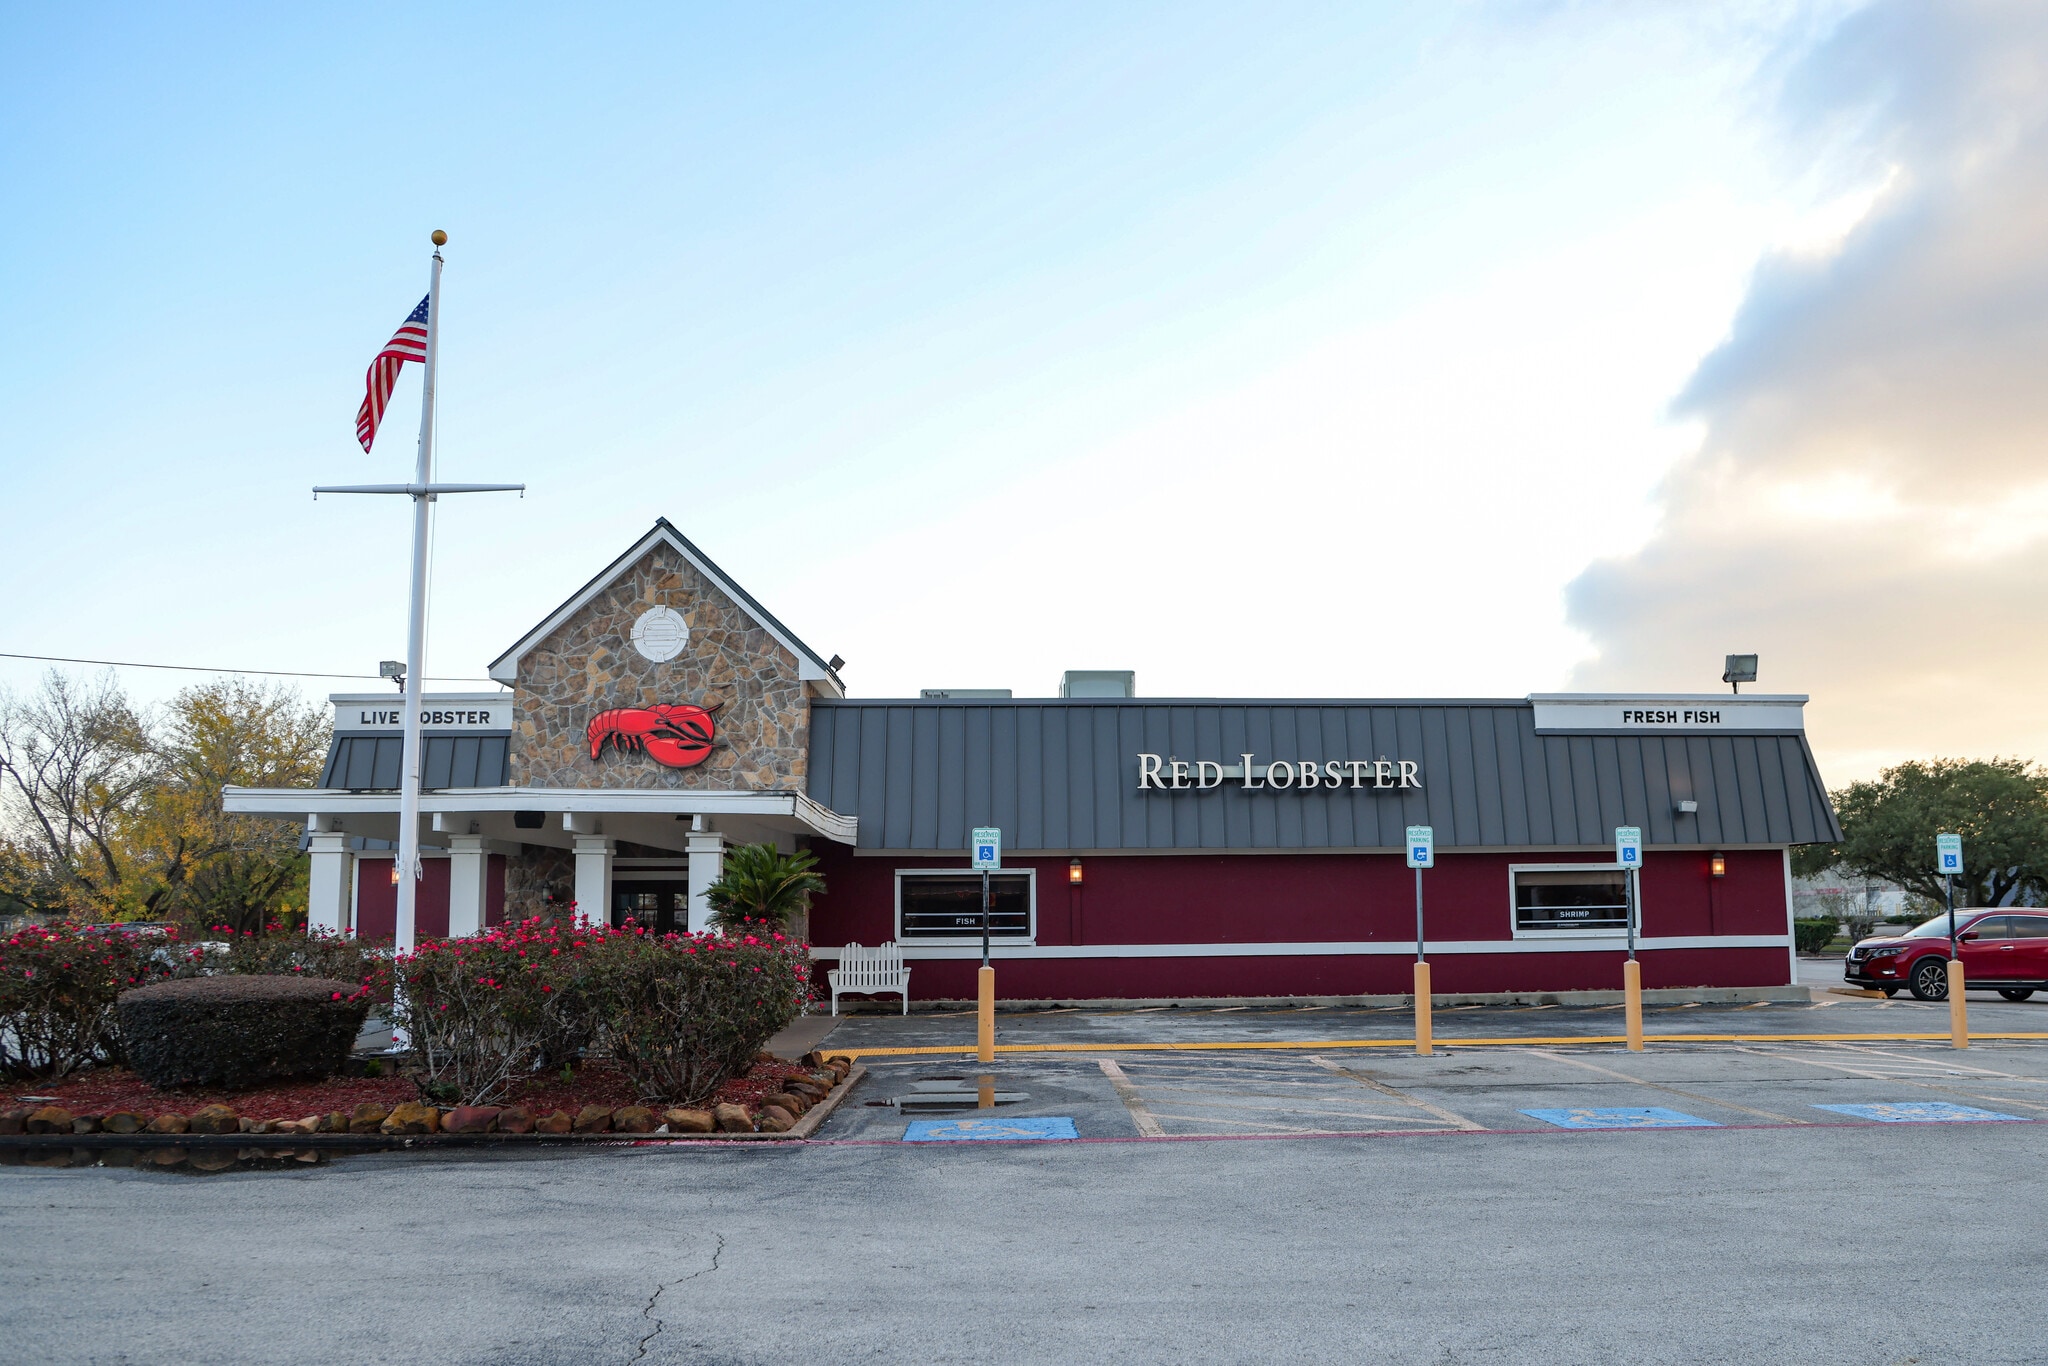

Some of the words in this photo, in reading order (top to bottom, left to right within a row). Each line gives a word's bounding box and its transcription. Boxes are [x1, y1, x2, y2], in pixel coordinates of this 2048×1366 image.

[361, 711, 400, 725] LIVE
[419, 711, 490, 725] OBSTER
[1623, 710, 1678, 724] FRESH
[1684, 710, 1720, 724] FISH
[1136, 753, 1224, 790] RED
[1240, 753, 1423, 790] LOBSTER
[1560, 910, 1590, 918] SHRIMP
